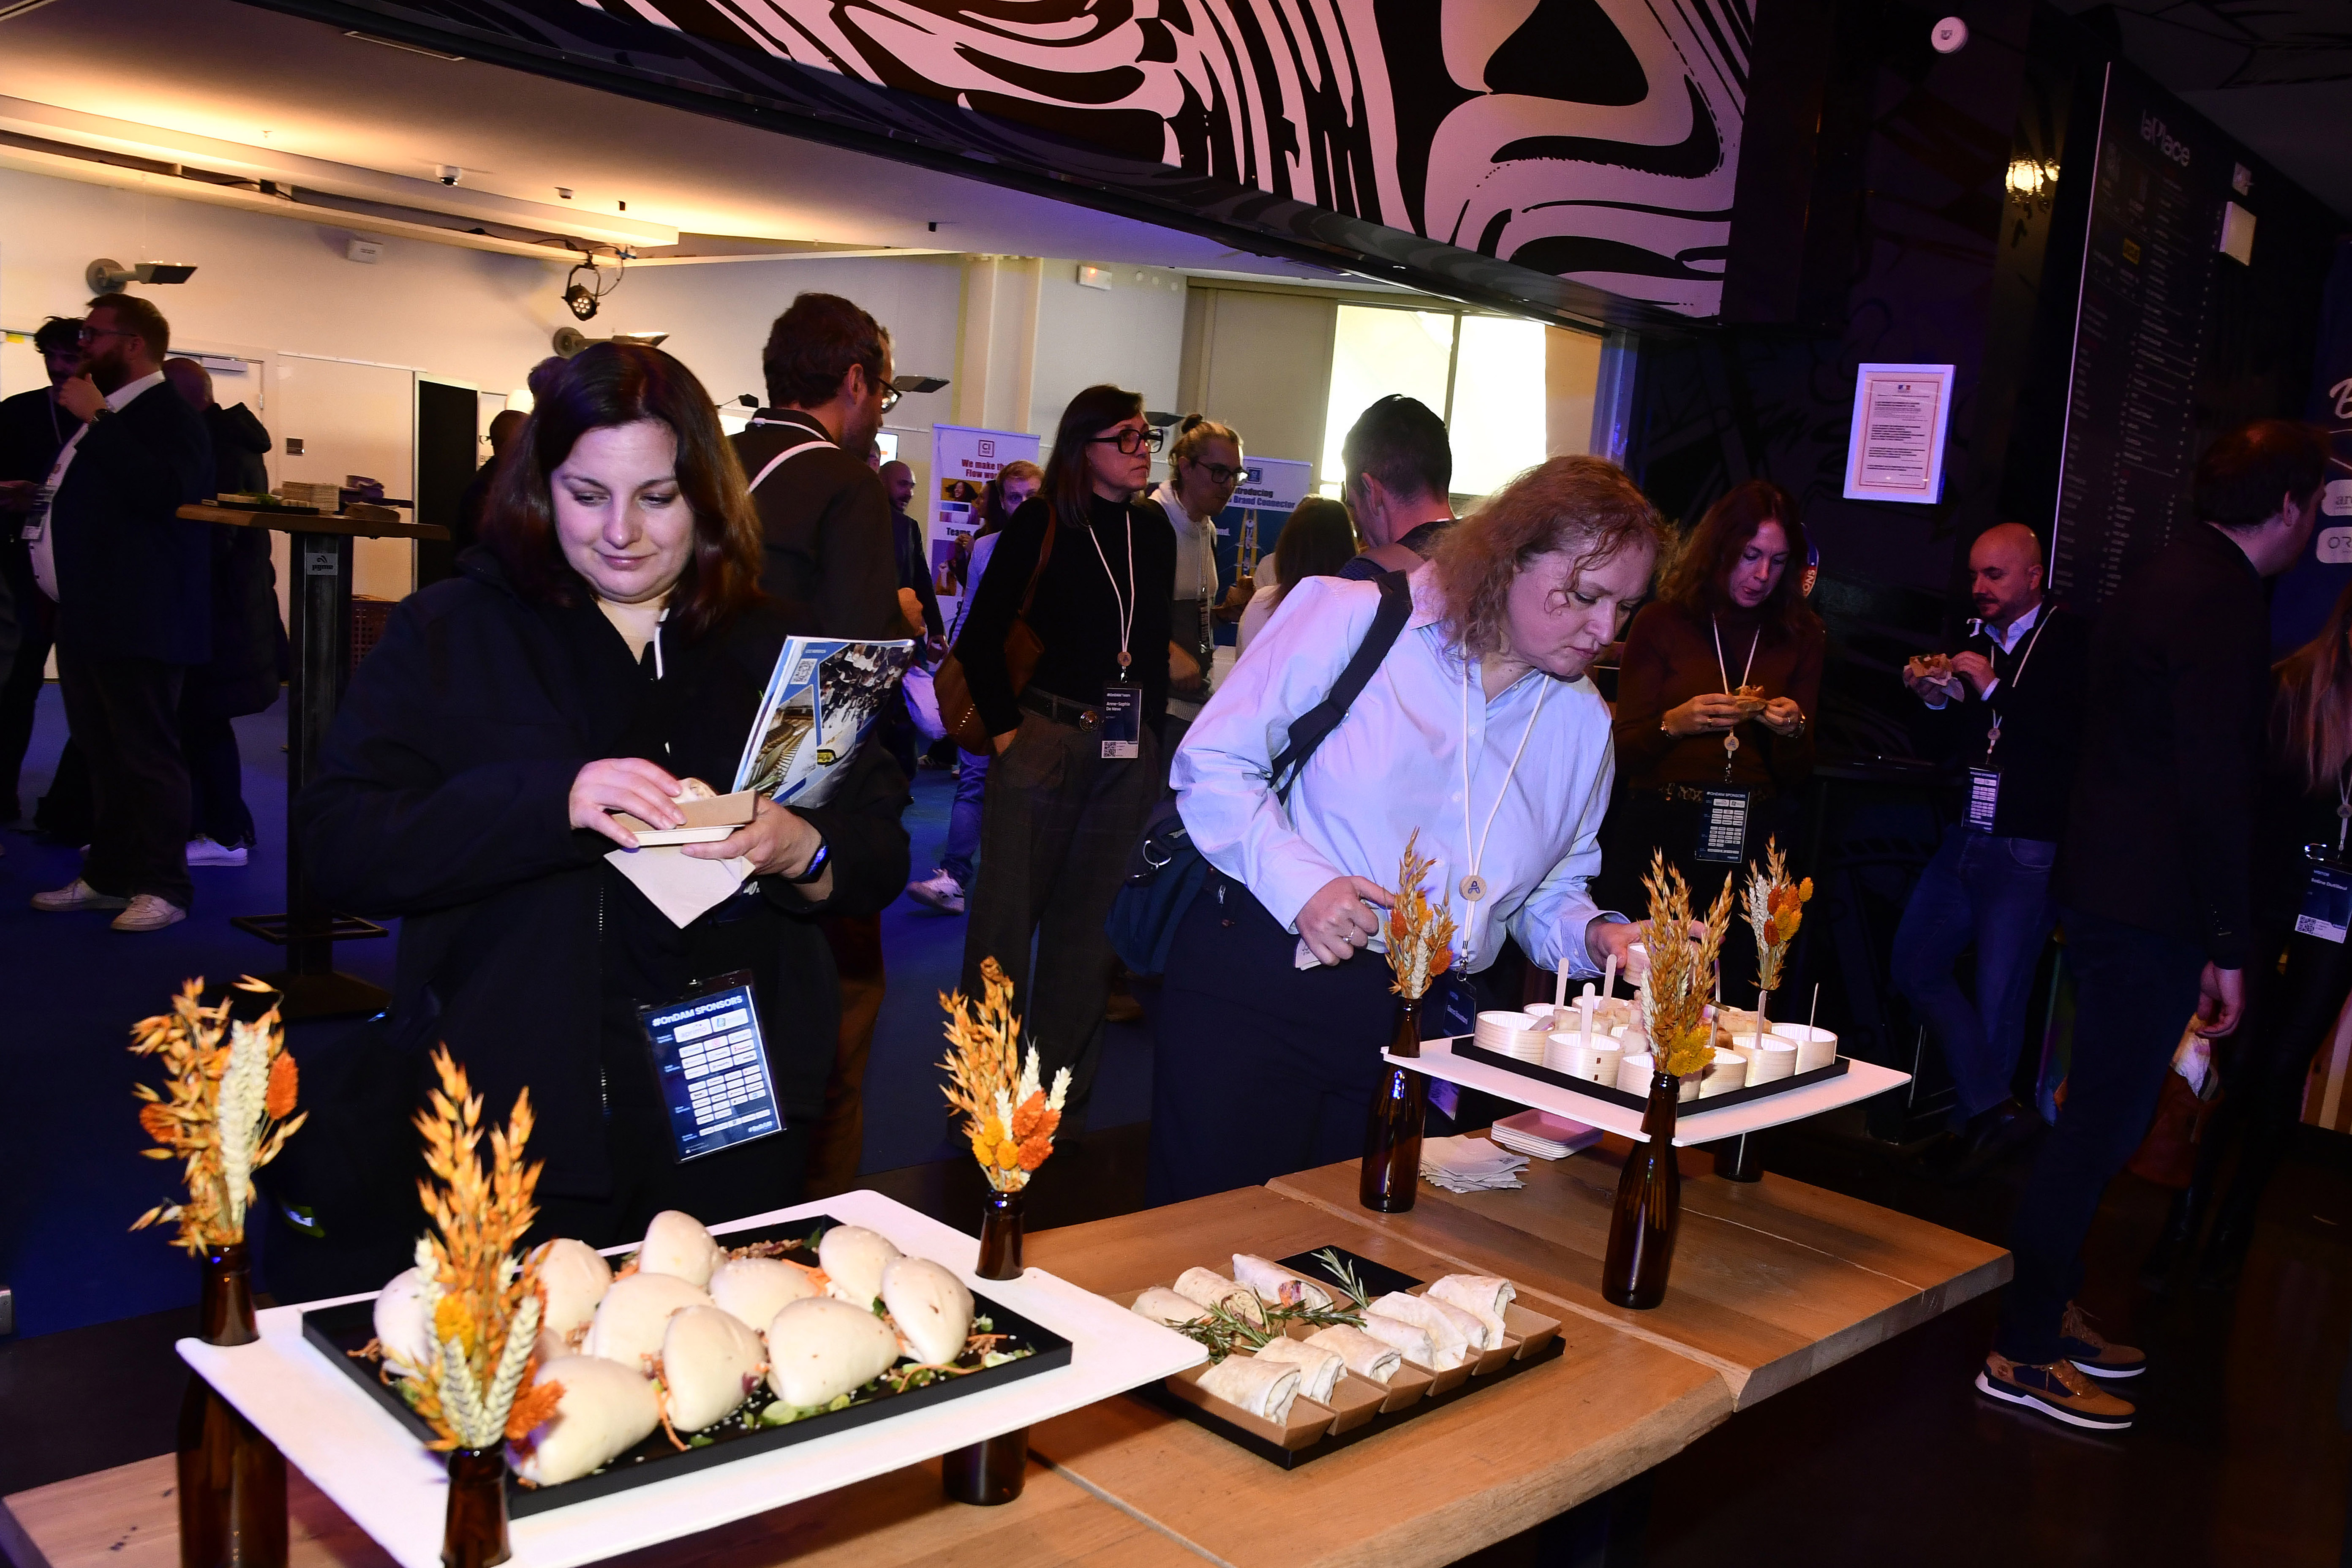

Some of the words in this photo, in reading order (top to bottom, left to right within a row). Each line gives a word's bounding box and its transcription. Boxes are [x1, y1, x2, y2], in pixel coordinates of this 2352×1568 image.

[961, 459, 973, 468] We
[975, 461, 995, 470] make
[966, 469, 982, 478] Flow
[1233, 495, 1255, 505] Brand
[1257, 498, 1296, 509] Connector
[652, 1009, 695, 1027] #OnDAM
[694, 995, 743, 1015] SPONSORS
